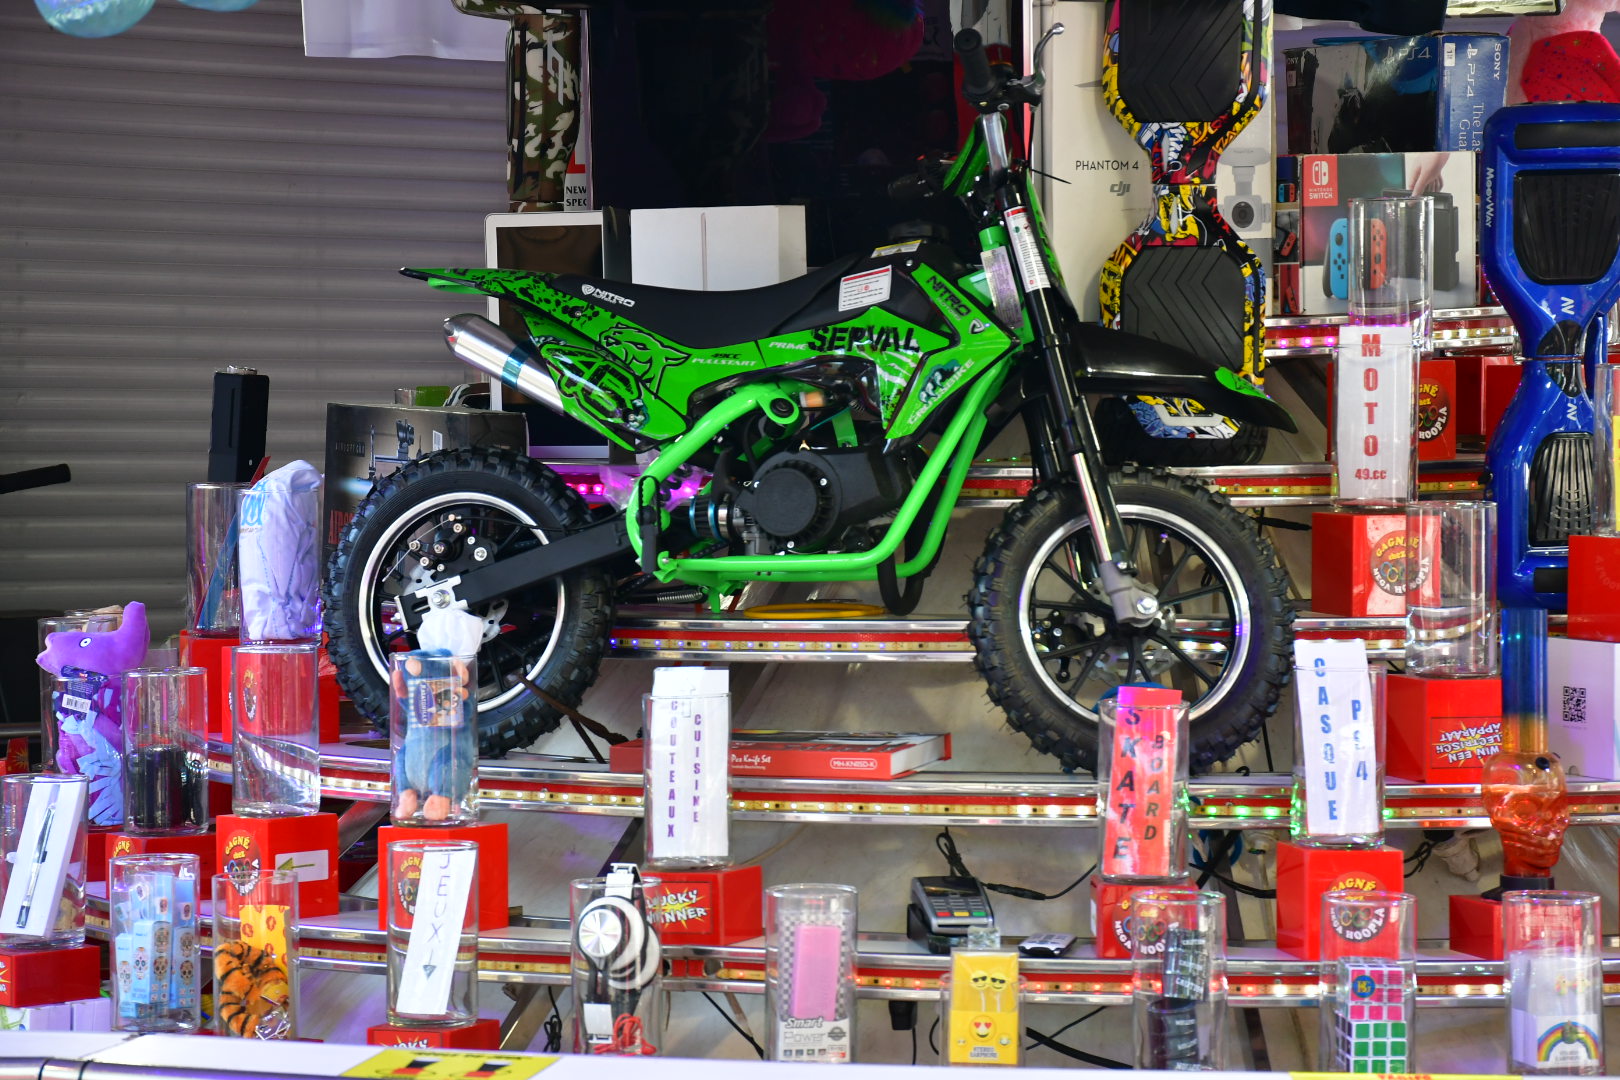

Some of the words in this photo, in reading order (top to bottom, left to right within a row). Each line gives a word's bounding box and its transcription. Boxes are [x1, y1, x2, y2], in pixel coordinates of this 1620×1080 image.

[1286, 56, 1299, 64] ONY
[1493, 43, 1502, 80] SONY
[1466, 63, 1477, 98] PS4
[1472, 102, 1485, 127] The
[1472, 131, 1483, 152] Las
[1075, 160, 1129, 171] PHANTOM
[1132, 160, 1139, 171] 4
[565, 185, 587, 194] NEW
[1309, 192, 1333, 200] SWITCH
[592, 288, 635, 308] NITRO
[926, 275, 972, 316] NITRO
[768, 341, 808, 350] PRIME
[807, 325, 921, 353] SERVAL
[692, 357, 757, 366] PULLSTART
[1361, 333, 1382, 457] MOTO
[1418, 406, 1448, 440] HOOPLA
[1354, 468, 1387, 480] 49.cc
[1314, 657, 1338, 821] CASQUE
[1439, 722, 1501, 742] APPARAAT
[1435, 734, 1502, 754] LECTRISCH
[1476, 745, 1500, 759] WIN
[743, 753, 761, 765] Knife
[761, 754, 772, 763] Set
[1447, 750, 1472, 764] EEN
[667, 700, 679, 838] COUTEAUX
[692, 713, 703, 823] CUISINE
[1112, 707, 1142, 859] SKATE
[1144, 734, 1165, 841] BOARD
[400, 856, 423, 873] GAGN
[427, 853, 454, 944] JEUX
[1345, 907, 1386, 941] HOOPLA
[1114, 920, 1132, 950] MEGA
[785, 1017, 824, 1029] Smart
